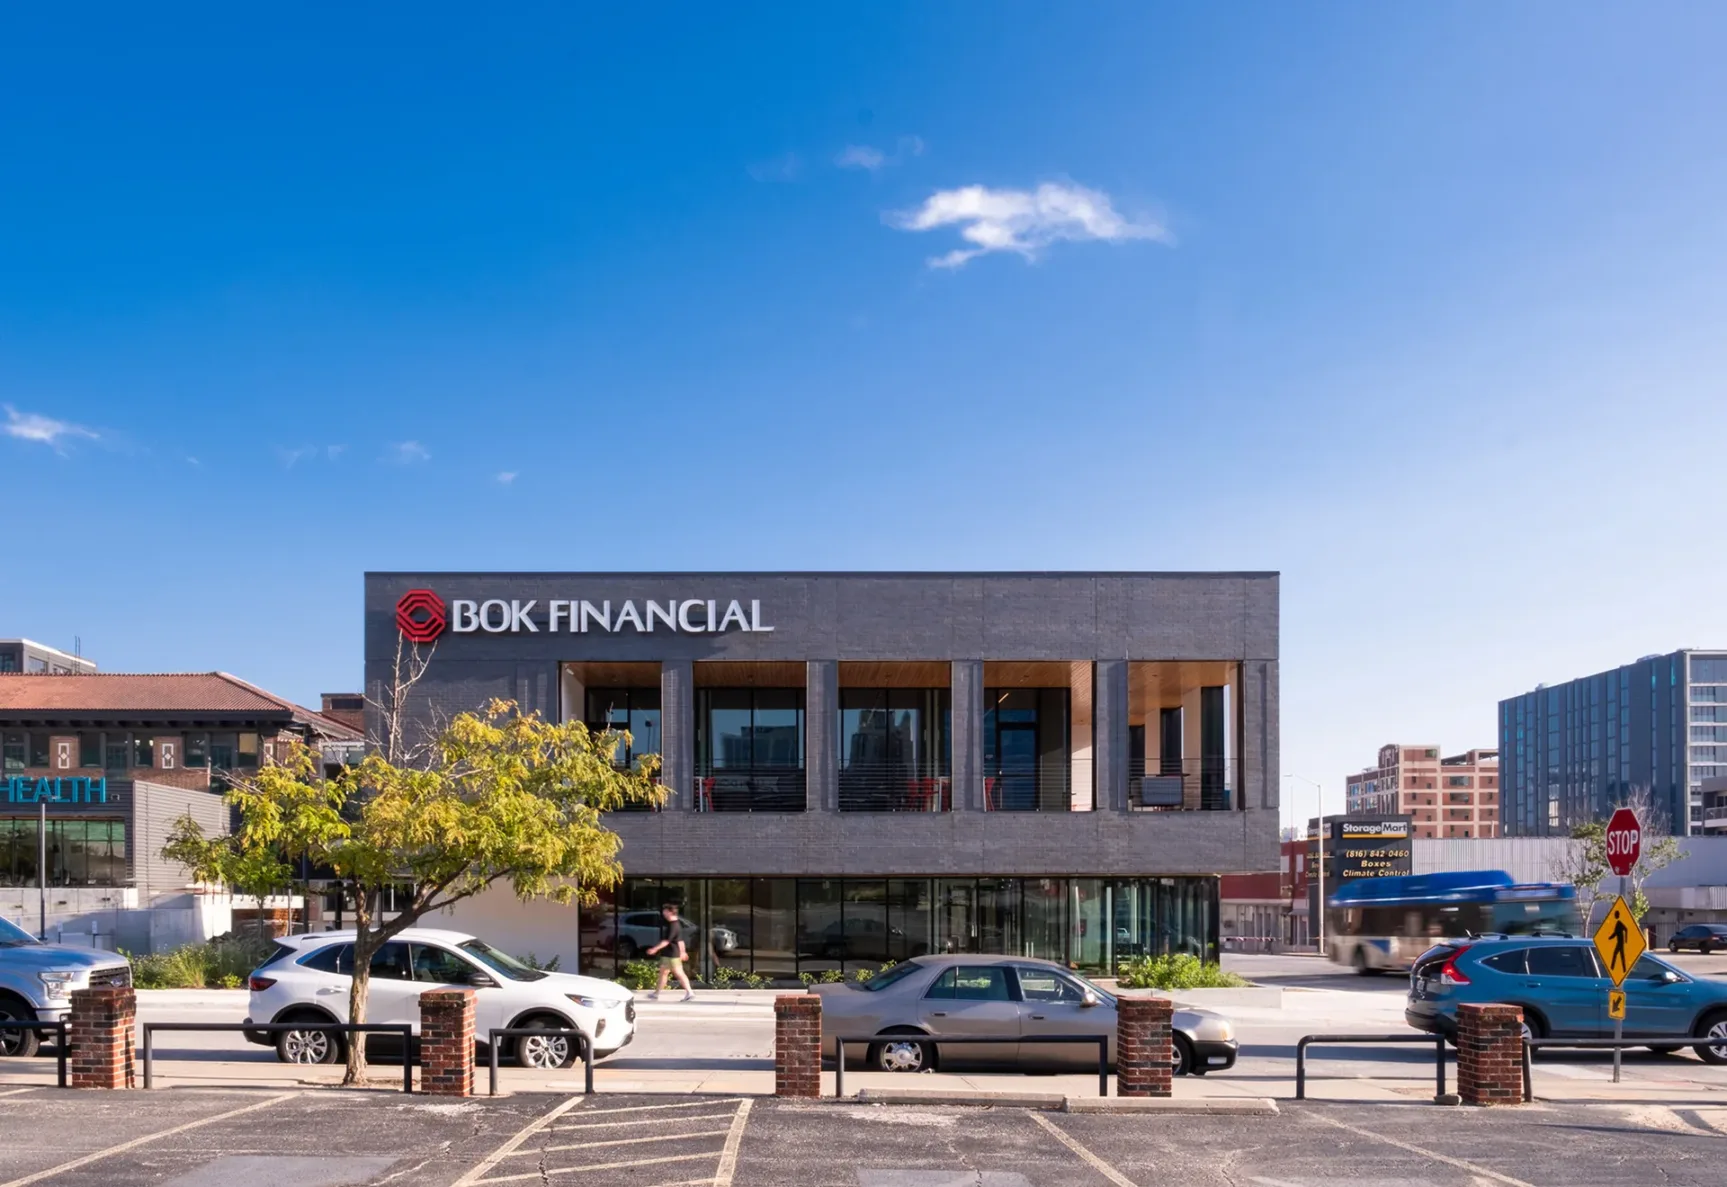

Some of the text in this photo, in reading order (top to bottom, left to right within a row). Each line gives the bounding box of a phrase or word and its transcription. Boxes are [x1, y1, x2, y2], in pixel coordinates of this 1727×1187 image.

[452, 599, 775, 633] BOK FINANCIAL
[0, 776, 107, 803] HEALTH
[1346, 850, 1367, 858] (816)
[1608, 829, 1639, 855] STOP
[1361, 860, 1392, 868] Boxes
